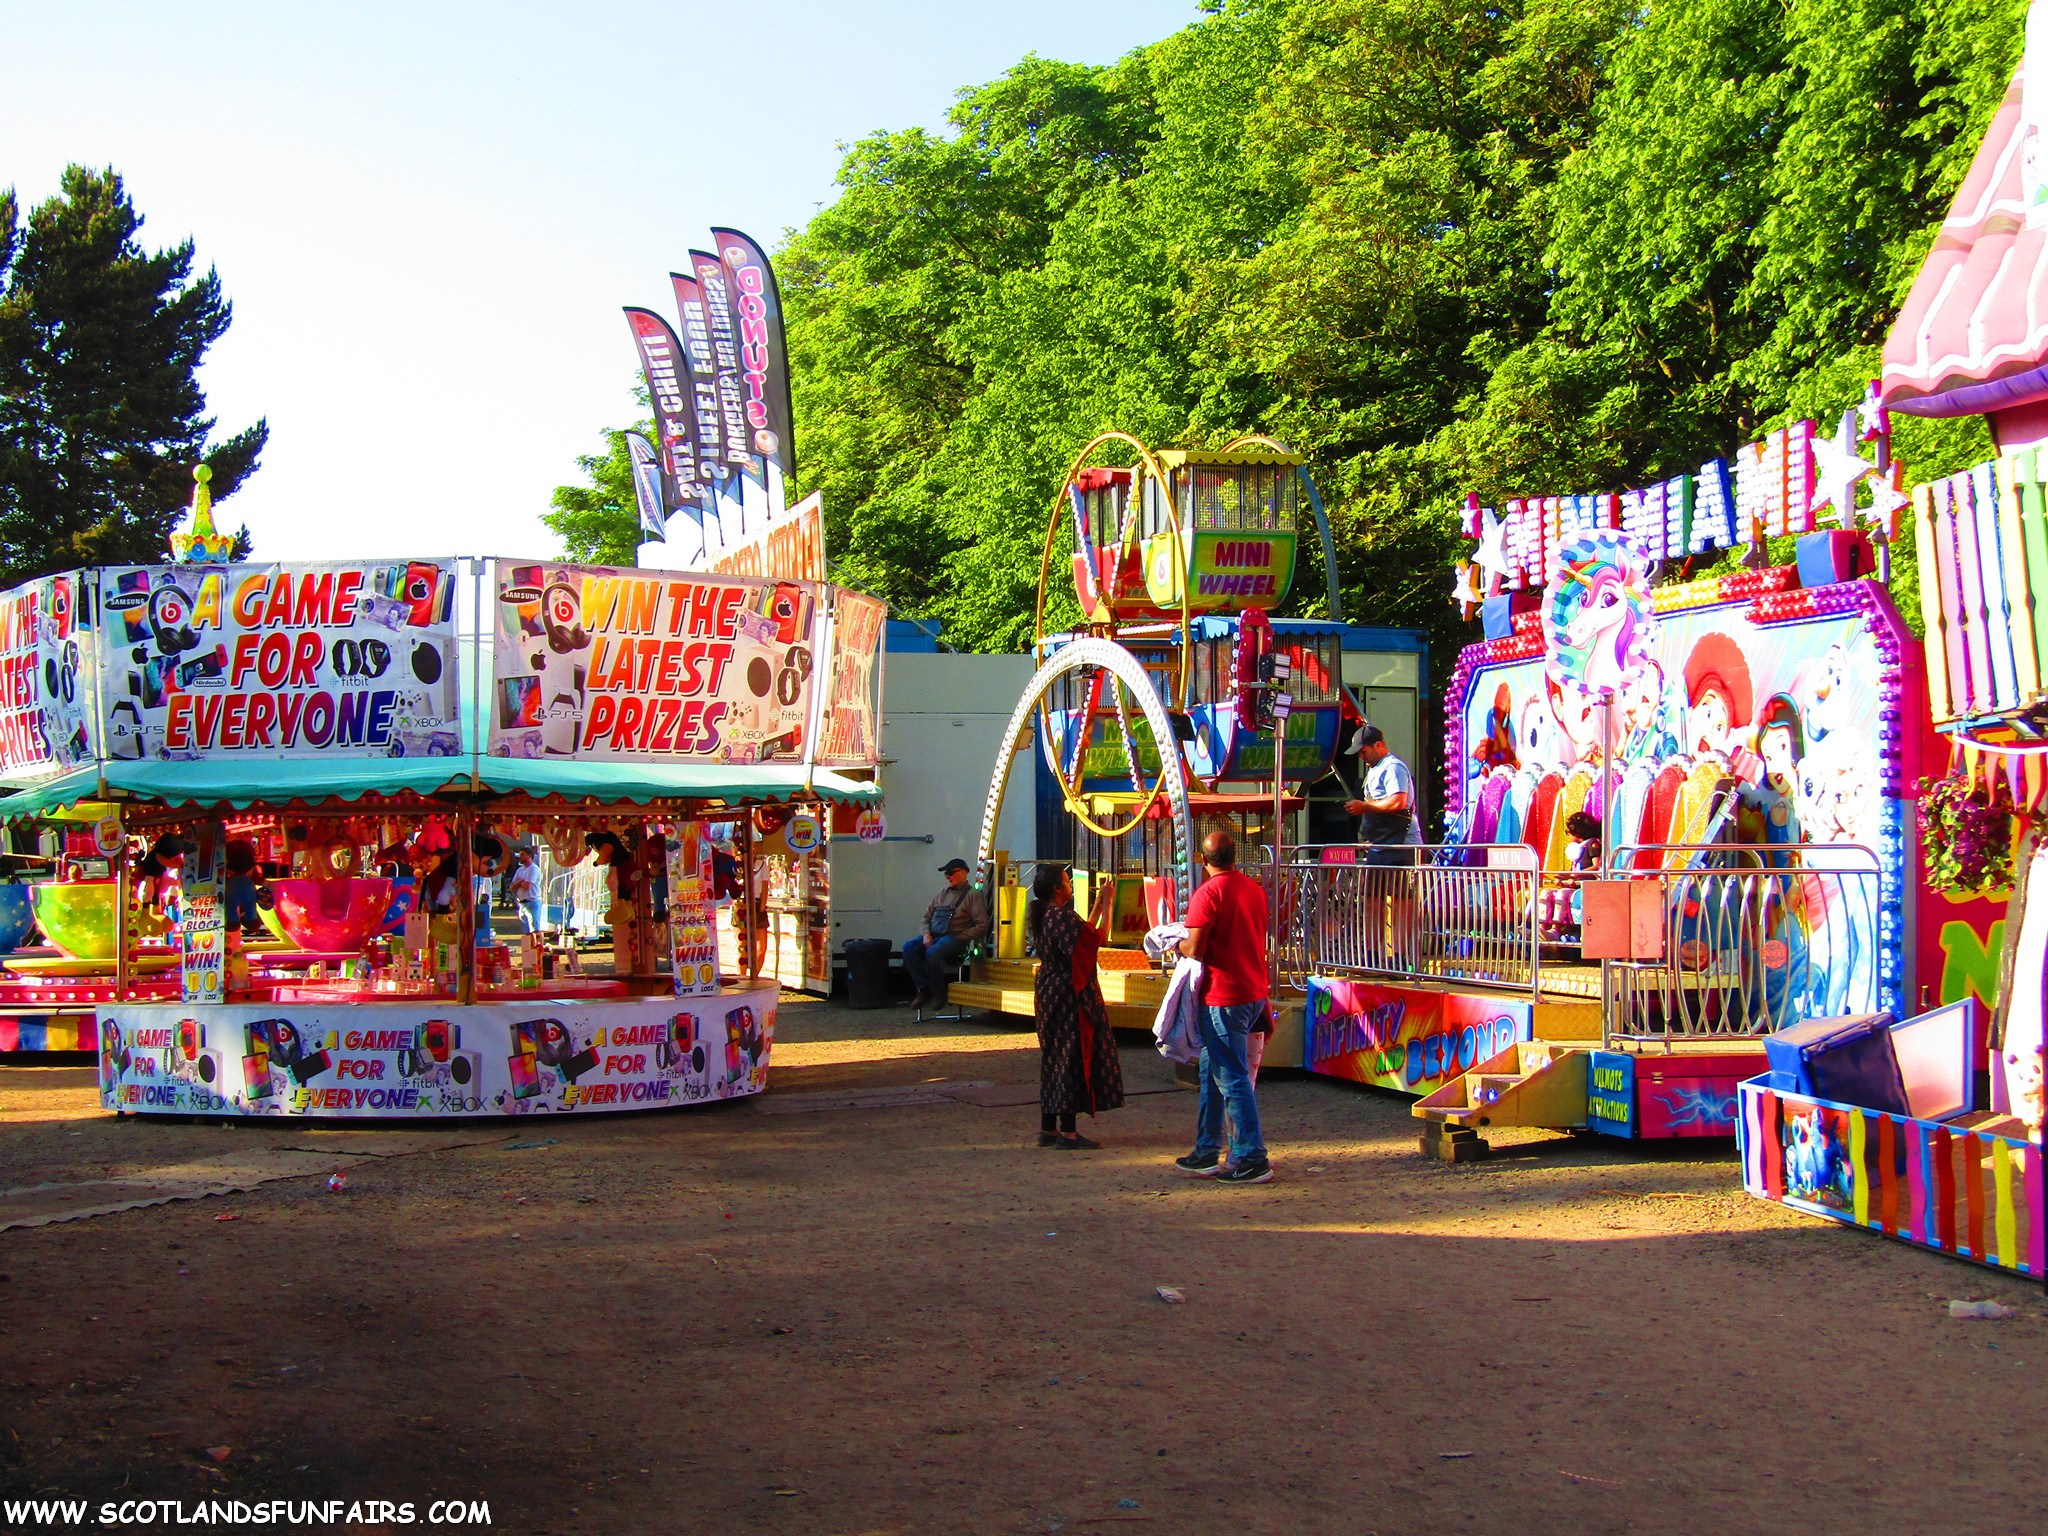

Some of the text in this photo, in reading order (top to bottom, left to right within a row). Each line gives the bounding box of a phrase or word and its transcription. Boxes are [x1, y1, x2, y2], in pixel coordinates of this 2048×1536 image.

[1215, 541, 1271, 568] MINI
[1200, 574, 1277, 596] WHEEL
[110, 598, 145, 606] SAMSUNG
[191, 571, 364, 630] A GAME
[504, 591, 540, 601] SAMSUNG
[581, 577, 749, 640] WIN THE
[229, 633, 325, 690] FOR
[585, 638, 735, 697] LATEST
[342, 675, 369, 687] fitbit
[166, 690, 399, 750] EVERYONE
[414, 717, 444, 728] XBOX
[550, 709, 583, 720] PS5
[781, 710, 804, 721] fitbit
[582, 695, 729, 754] PRIZES
[742, 730, 766, 740] XBOX
[860, 826, 883, 839] CASH
[1329, 850, 1354, 862] WAY OUT
[1492, 852, 1521, 864] WAY IN
[190, 895, 217, 908] OVER
[677, 891, 708, 903] OVER
[193, 907, 214, 919] THE
[682, 904, 704, 915] THE
[186, 920, 221, 932] BLOCK
[675, 915, 712, 927] BLOCK
[192, 933, 215, 951] TO
[683, 928, 708, 945] TO
[185, 952, 222, 970] WIN!
[675, 946, 715, 965] WIN!
[1314, 987, 1333, 1017] TO
[137, 1029, 173, 1049] GAME
[593, 1024, 668, 1047] A GAME
[1312, 998, 1406, 1063] INFINITY
[324, 1030, 413, 1051] A GAME
[1406, 1015, 1516, 1085] BEYOND
[134, 1057, 156, 1077] FOR
[336, 1059, 385, 1080] FOR
[604, 1054, 647, 1076] FOR
[1375, 1044, 1405, 1076] AND
[412, 1078, 439, 1089] fitbit
[564, 1079, 671, 1105] EVERYONE
[117, 1085, 176, 1107] EVERYONE
[191, 1095, 228, 1111] XBOX
[295, 1088, 420, 1110] EVERYONE
[439, 1097, 488, 1112] XBOX
[1588, 1096, 1628, 1123] ATTRACTIONS
